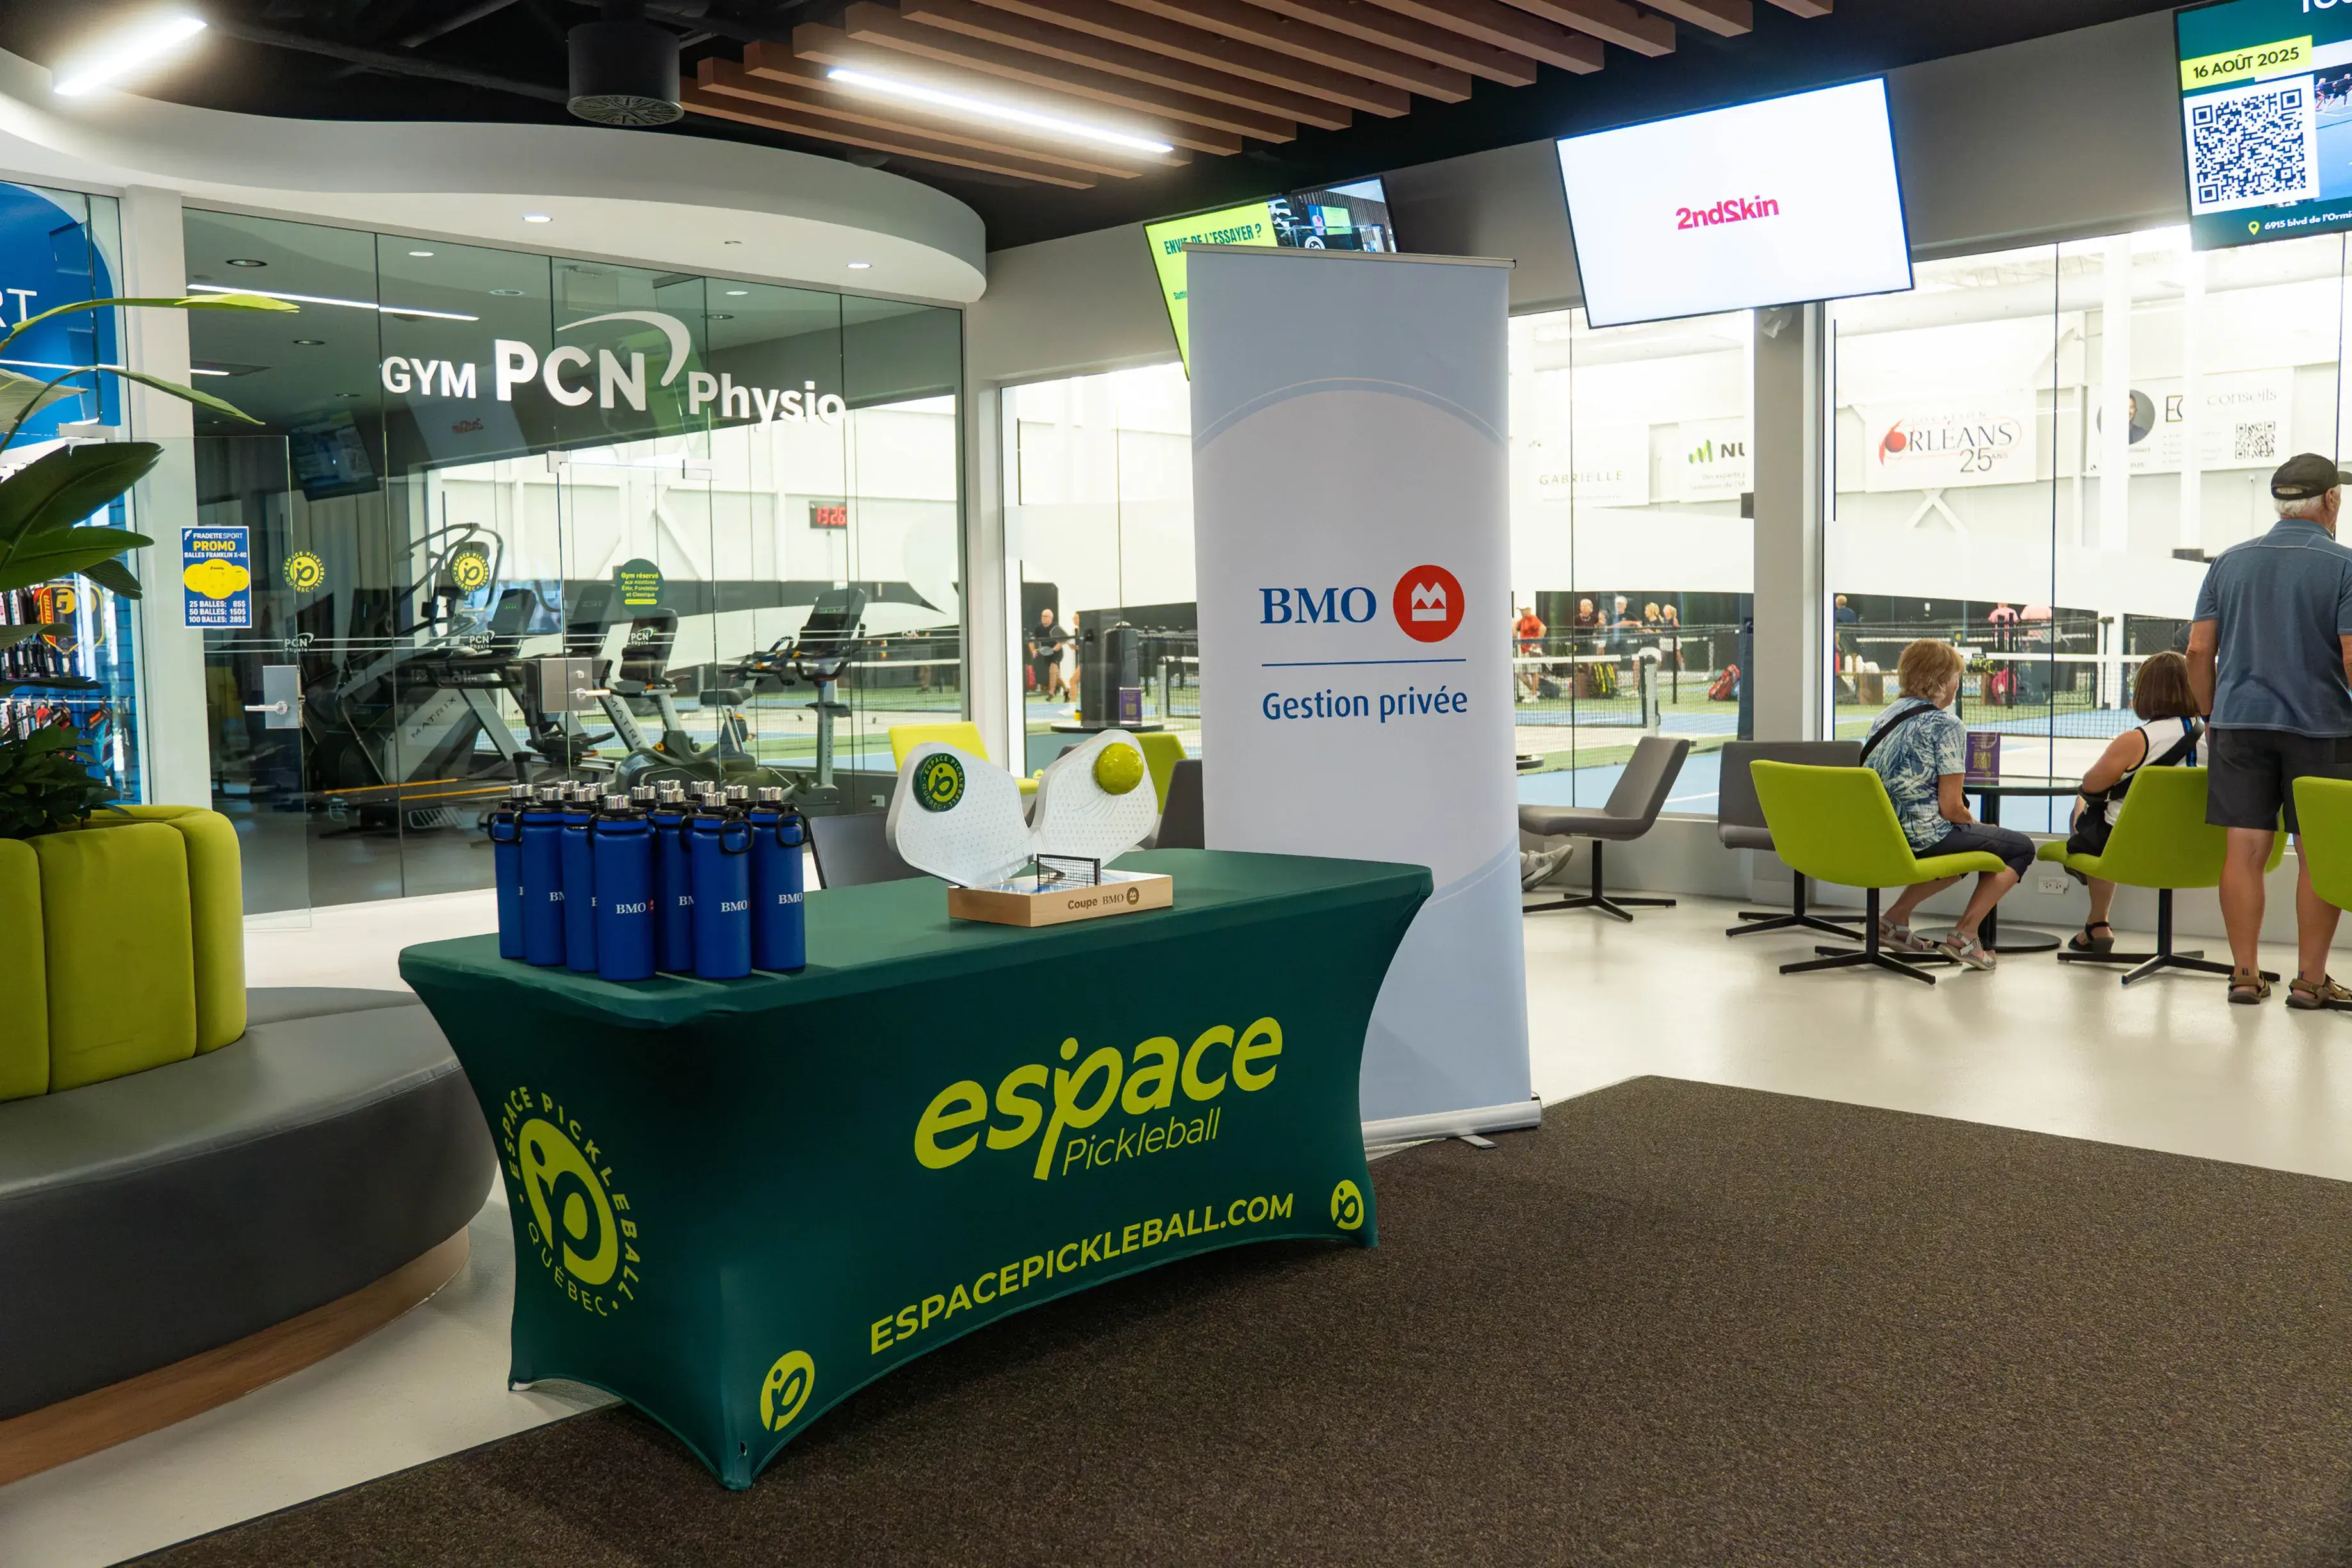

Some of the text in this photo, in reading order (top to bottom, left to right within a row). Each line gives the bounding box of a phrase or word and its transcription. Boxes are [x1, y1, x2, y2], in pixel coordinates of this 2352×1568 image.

[2193, 47, 2299, 78] 16 AOÛT 2025
[1676, 195, 1779, 230] 2ndSkin
[2264, 220, 2286, 230] 6915
[2287, 217, 2307, 227] blvd
[1164, 237, 1188, 255] ENV
[382, 339, 847, 432] GYM PCN Physio
[1960, 447, 1993, 473] 25
[1540, 468, 1623, 486] GABRIELLE
[193, 541, 236, 551] PROMO
[1259, 586, 1376, 624] BMO
[284, 637, 308, 648] PCN
[469, 635, 489, 644] PCN
[630, 632, 649, 641] PCN
[411, 697, 456, 738] MATRIX
[1262, 685, 1468, 723] Gestion privée
[608, 694, 641, 746] MATRI
[924, 756, 964, 807] ESPACE PICKLEBALL
[616, 902, 646, 914] BMO
[721, 900, 748, 912] BMO
[778, 892, 803, 904] BMO
[1068, 894, 1124, 910] Coupe BMO
[914, 1016, 1283, 1181] espace
[1062, 1106, 1221, 1177] Pickleball
[502, 1086, 641, 1302] ESPACE PICKLEBALL
[870, 1192, 1294, 1355] ESPACEPICKLEBALL.COM
